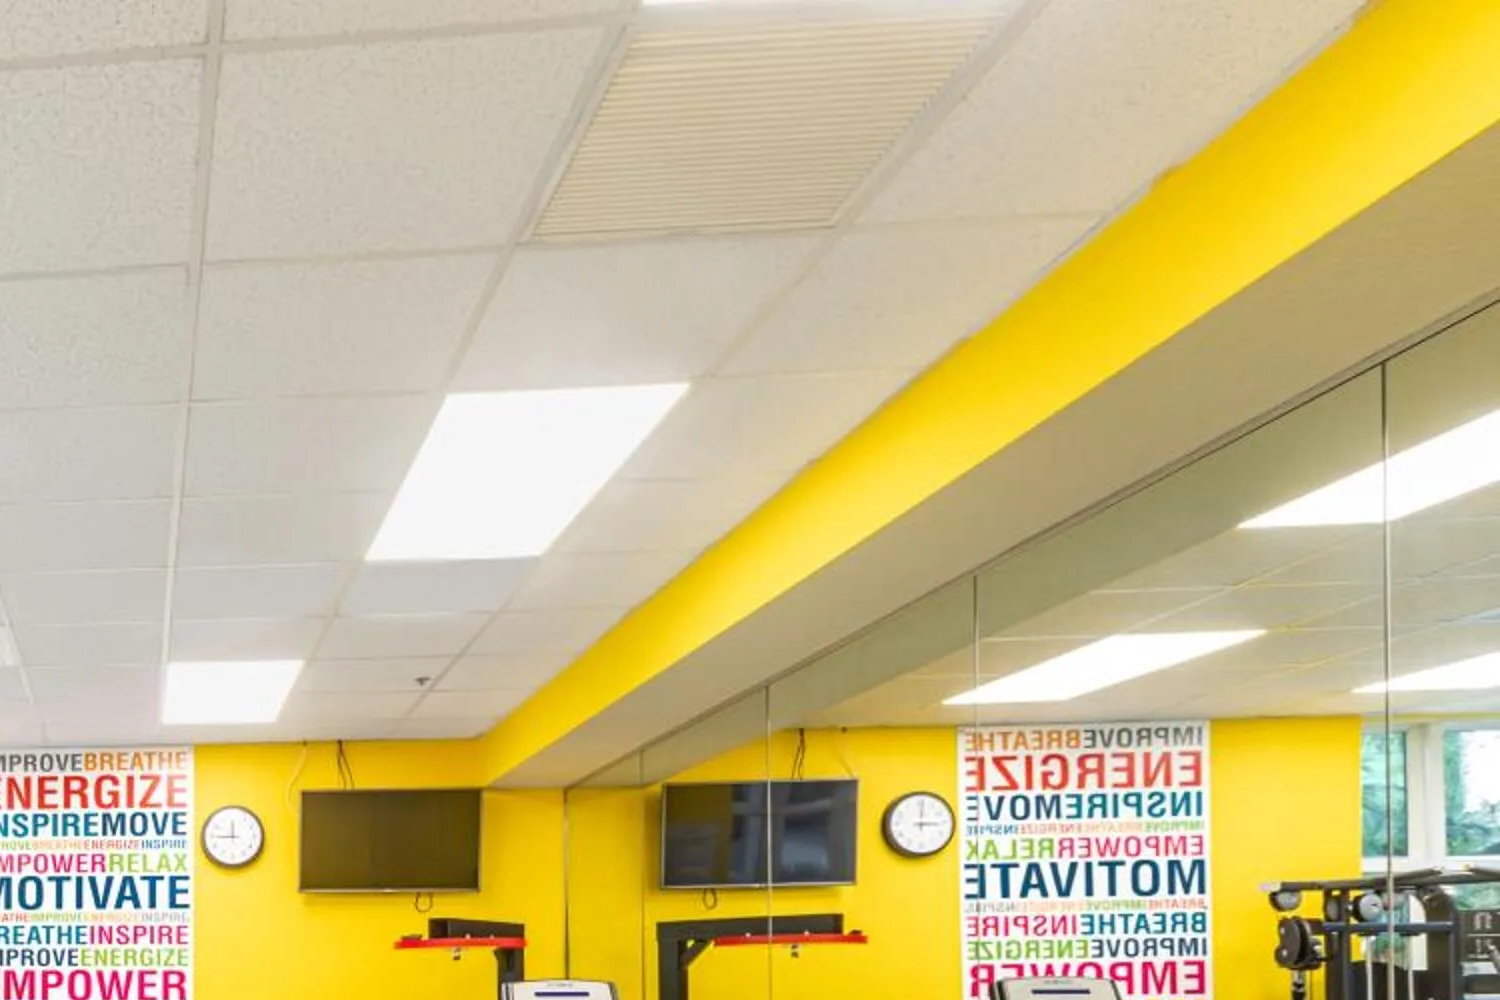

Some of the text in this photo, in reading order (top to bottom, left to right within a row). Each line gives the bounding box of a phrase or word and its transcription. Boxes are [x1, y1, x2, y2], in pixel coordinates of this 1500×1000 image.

[84, 751, 187, 772] BREATHE
[101, 811, 187, 837] MOVE
[108, 853, 188, 873] RELAX
[90, 925, 189, 945] INSPIRE
[80, 948, 189, 967] ENERGIZE
